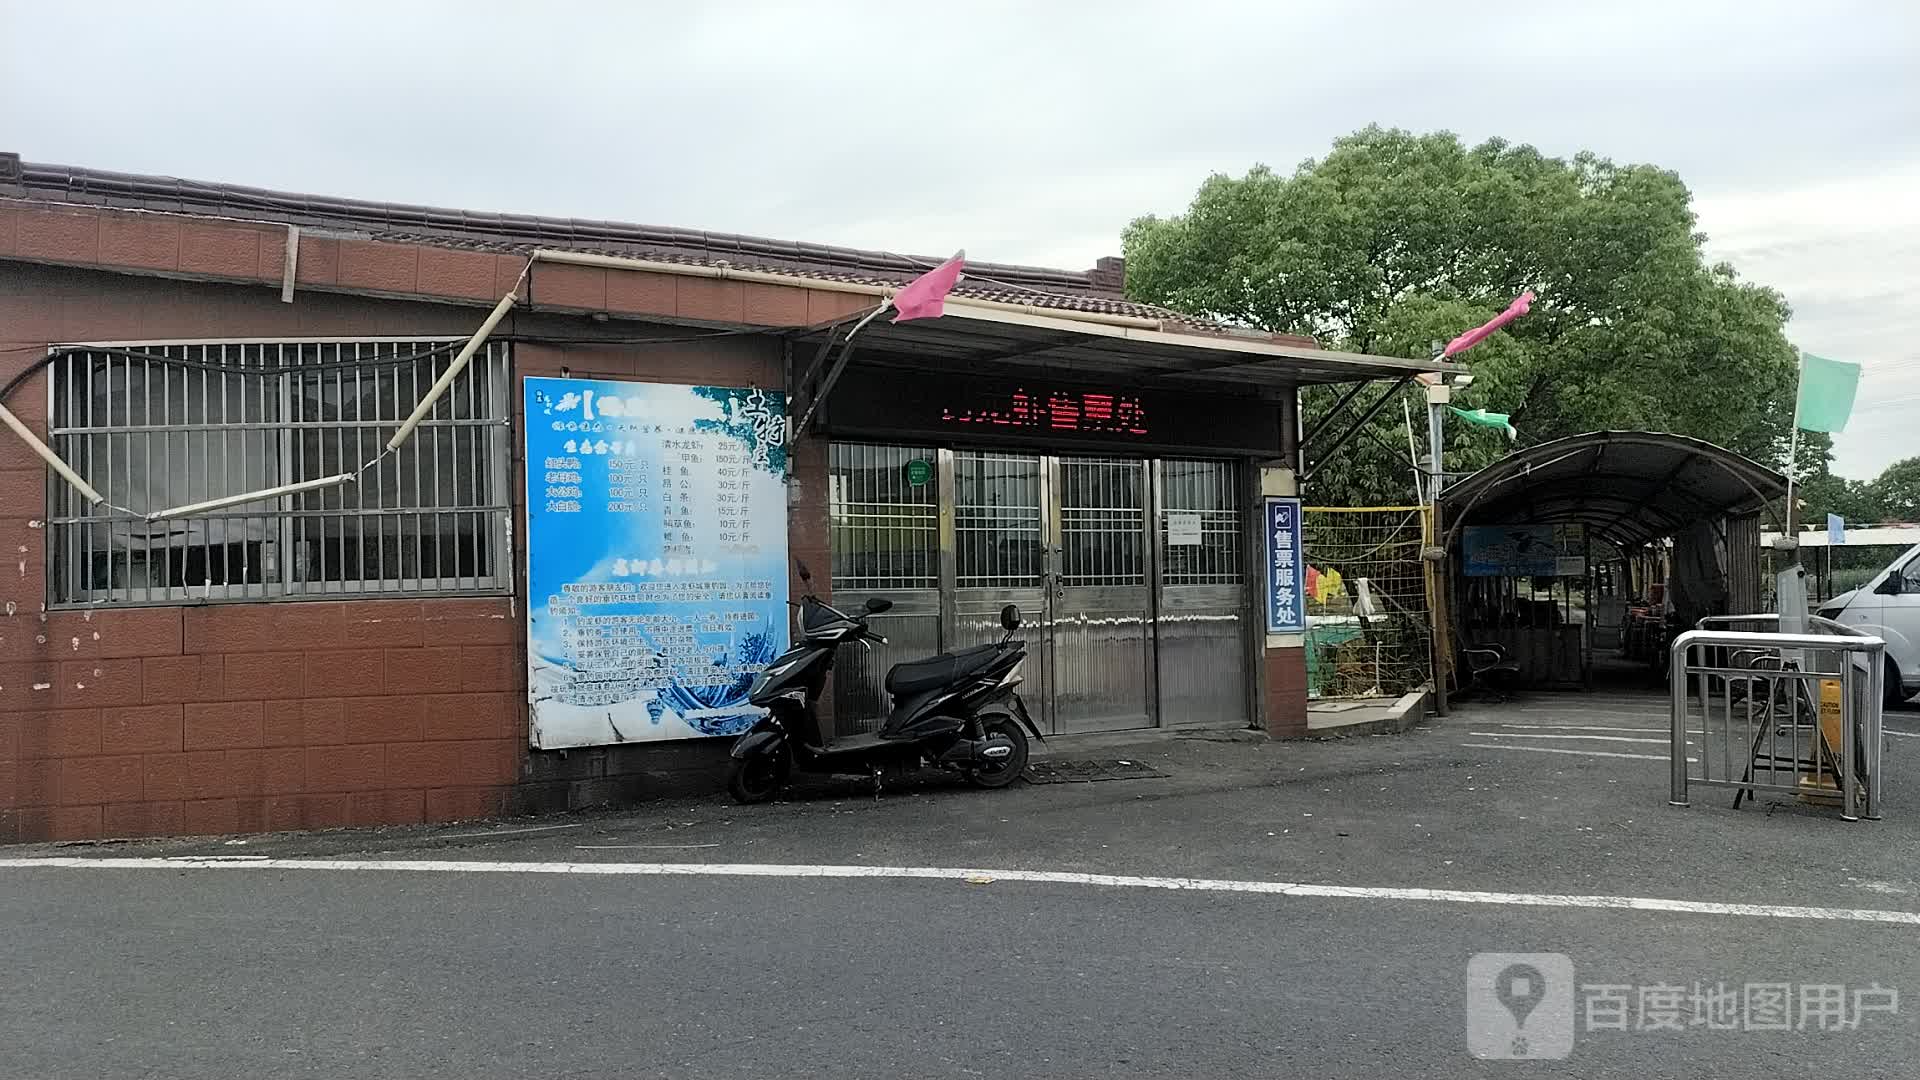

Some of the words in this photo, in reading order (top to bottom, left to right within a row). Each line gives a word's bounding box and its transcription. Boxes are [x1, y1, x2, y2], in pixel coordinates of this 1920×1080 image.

[1274, 530, 1297, 625] 售票服务处
